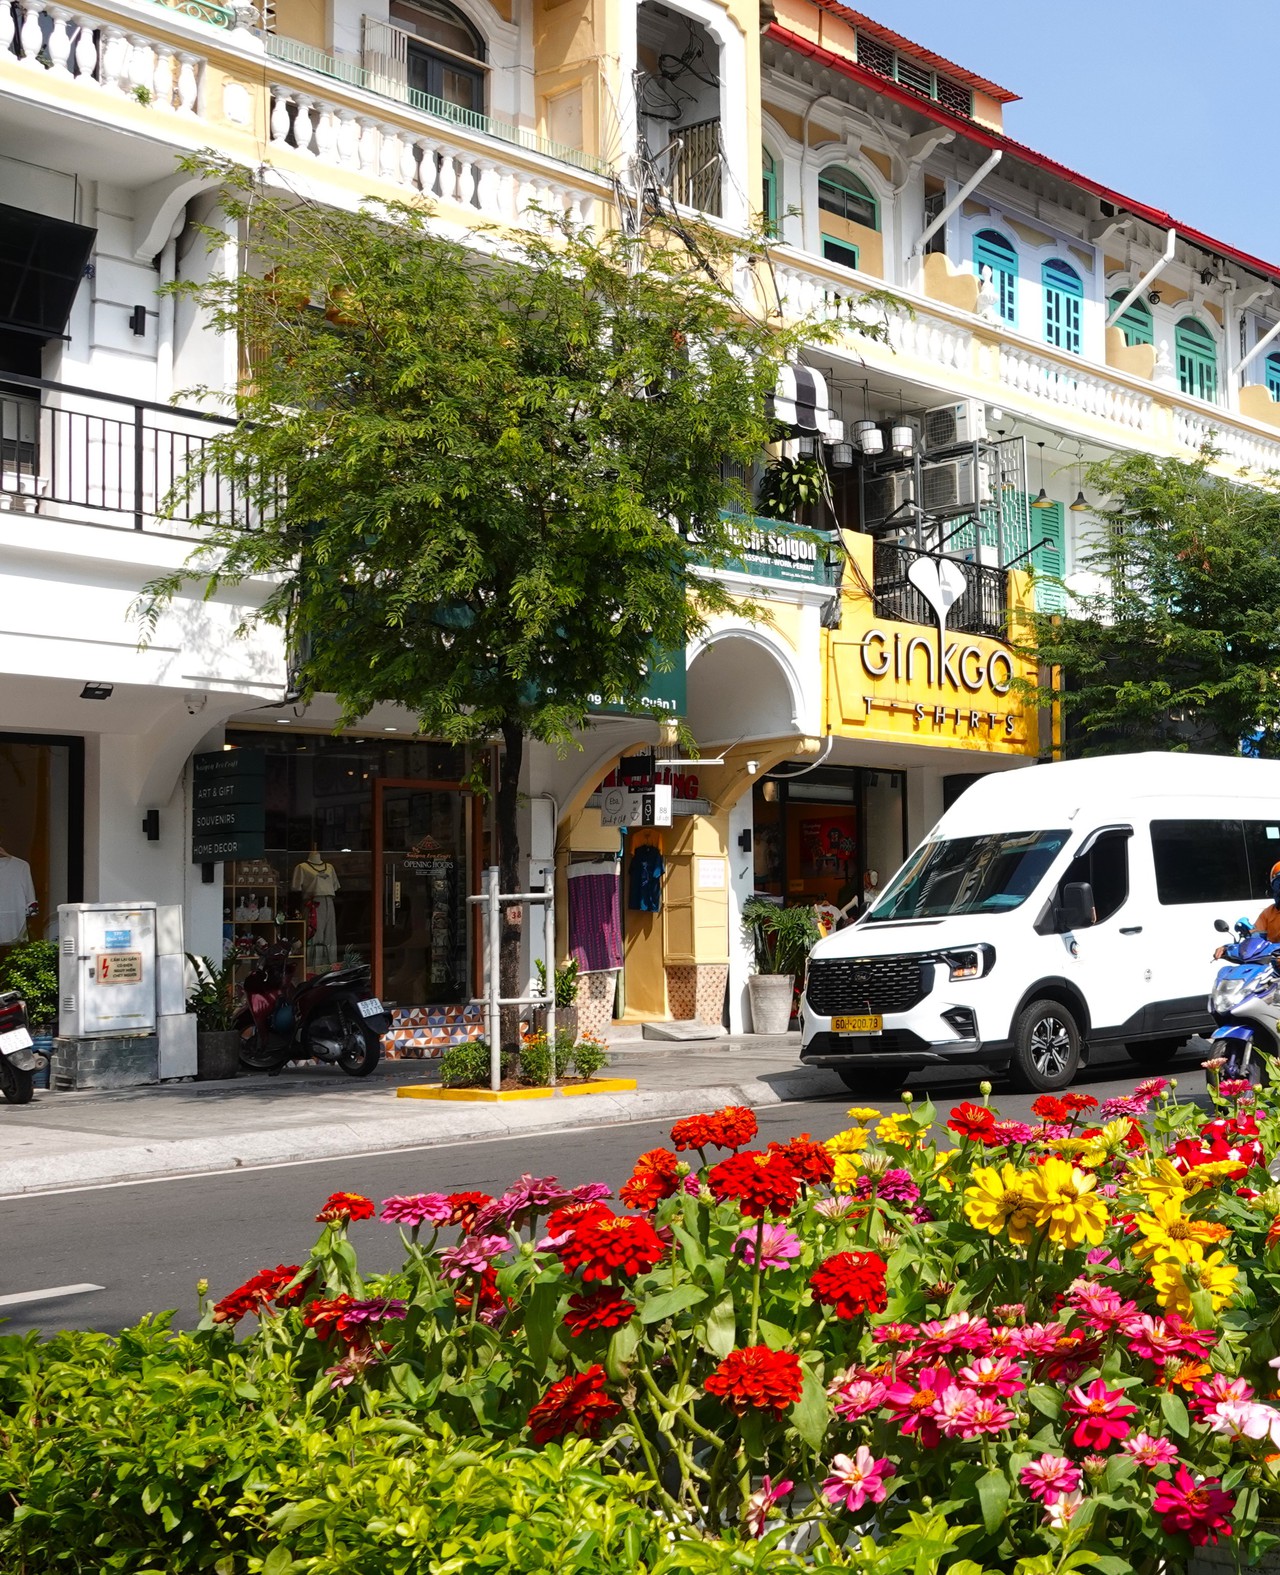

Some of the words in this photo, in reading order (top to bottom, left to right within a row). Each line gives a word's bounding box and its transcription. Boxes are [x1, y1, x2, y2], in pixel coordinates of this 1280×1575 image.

[767, 530, 817, 560] Saigon
[774, 559, 792, 568] WORK
[792, 562, 815, 572] PERMIT
[198, 788, 211, 799] ART
[218, 785, 234, 797] GIFT
[197, 814, 235, 827] SOUVENIRS
[194, 844, 212, 855] HOME
[214, 842, 238, 854] DECOR
[404, 860, 431, 868] OPENING
[432, 861, 454, 869] HOURS
